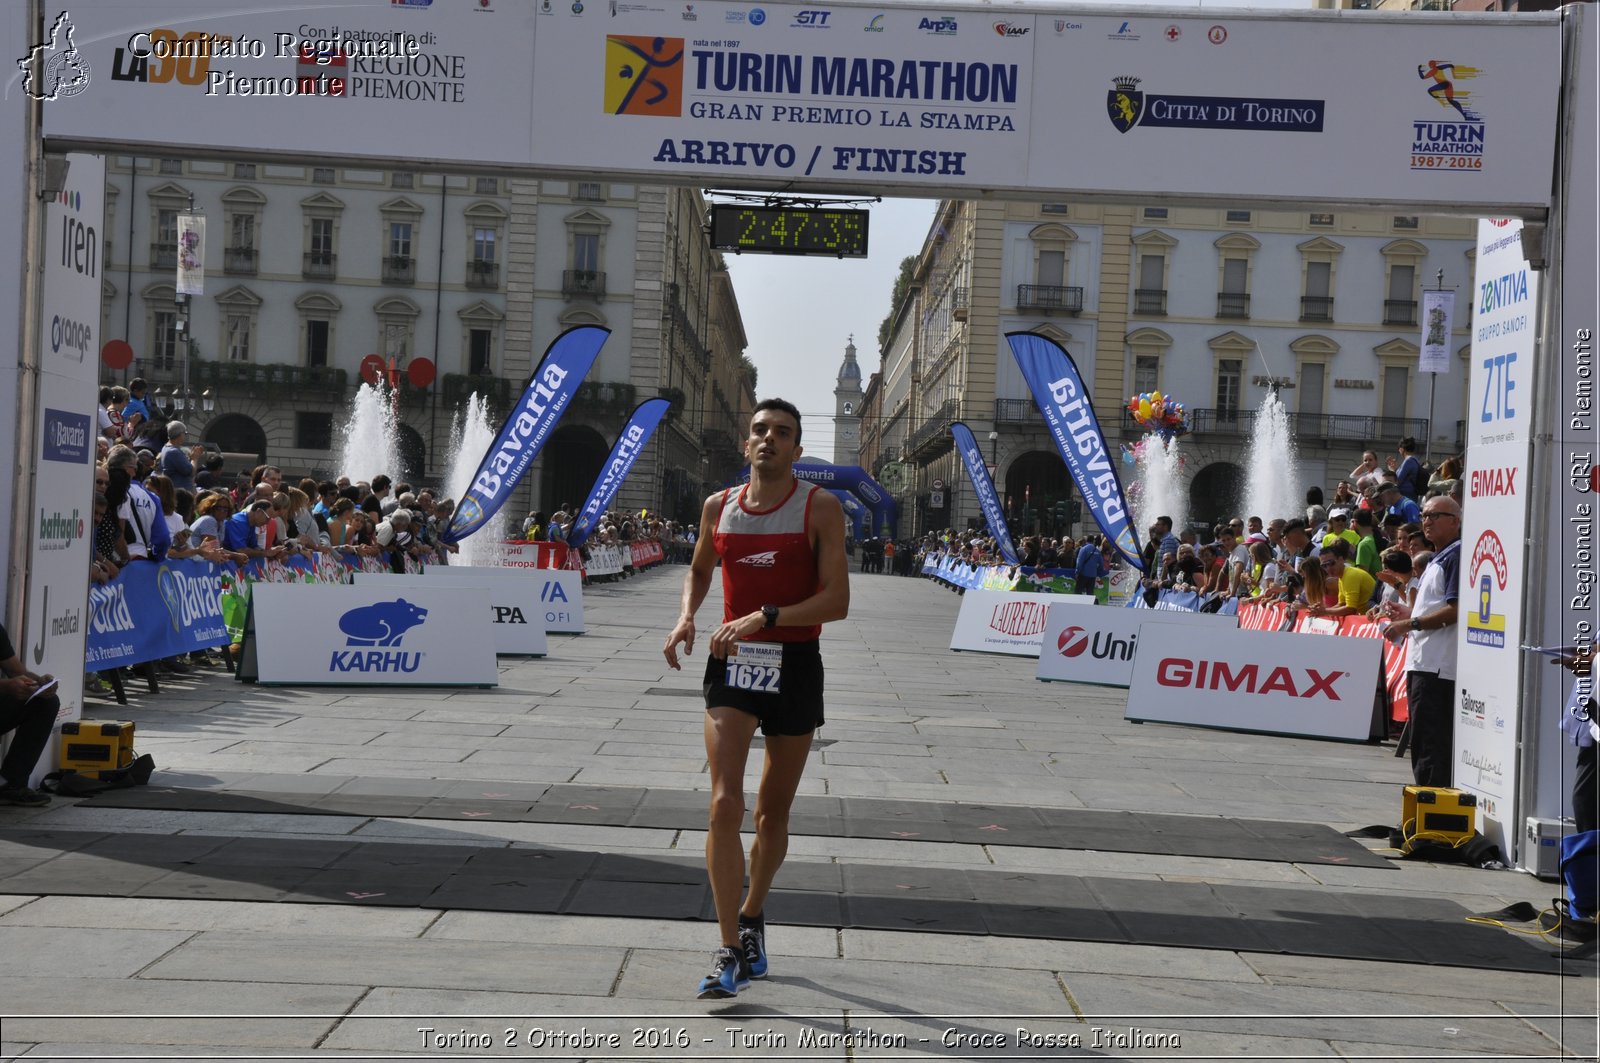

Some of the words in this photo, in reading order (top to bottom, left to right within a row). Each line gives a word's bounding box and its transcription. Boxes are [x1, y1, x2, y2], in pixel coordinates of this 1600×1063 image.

[298, 24, 328, 39] Con
[331, 26, 339, 41] il
[419, 32, 437, 46] di:
[1007, 27, 1030, 36] IAAF
[1065, 22, 1082, 30] Coni
[693, 39, 709, 47] nata
[723, 40, 740, 48] 1897
[352, 52, 466, 79] REGIONE
[692, 50, 802, 94] TURIN
[811, 56, 1018, 103] MARATHON
[351, 77, 466, 103] PIEMONTE
[690, 101, 762, 121] GRAN
[772, 106, 872, 126] PREMIO
[880, 111, 912, 127] LA
[920, 111, 1016, 132] STAMPA
[1413, 123, 1485, 143] TURIN
[653, 138, 797, 169] ARRIVO
[832, 146, 967, 176] FINISH
[1412, 142, 1484, 153] MARATHON
[1478, 322, 1500, 342] GRUPPO
[1502, 314, 1528, 335] SANOFI
[1481, 352, 1518, 423] ZTE
[56, 421, 85, 448] Bavaria
[472, 363, 568, 500] Bavaria
[505, 448, 533, 488] Holland's
[529, 412, 556, 449] Premium
[552, 391, 568, 412] Beer
[586, 424, 645, 515] Bavaria
[1471, 467, 1517, 498] GIMAX
[40, 507, 84, 549] battaglio
[507, 546, 523, 556] più
[736, 557, 776, 565] ALTRA
[51, 607, 80, 637] medical
[491, 605, 528, 625] PA
[121, 642, 135, 656] Beer
[329, 650, 422, 673] KARHU
[726, 664, 781, 692] 1622
[1156, 657, 1345, 701] GIMAX
[1461, 749, 1503, 785] Mirafiori
